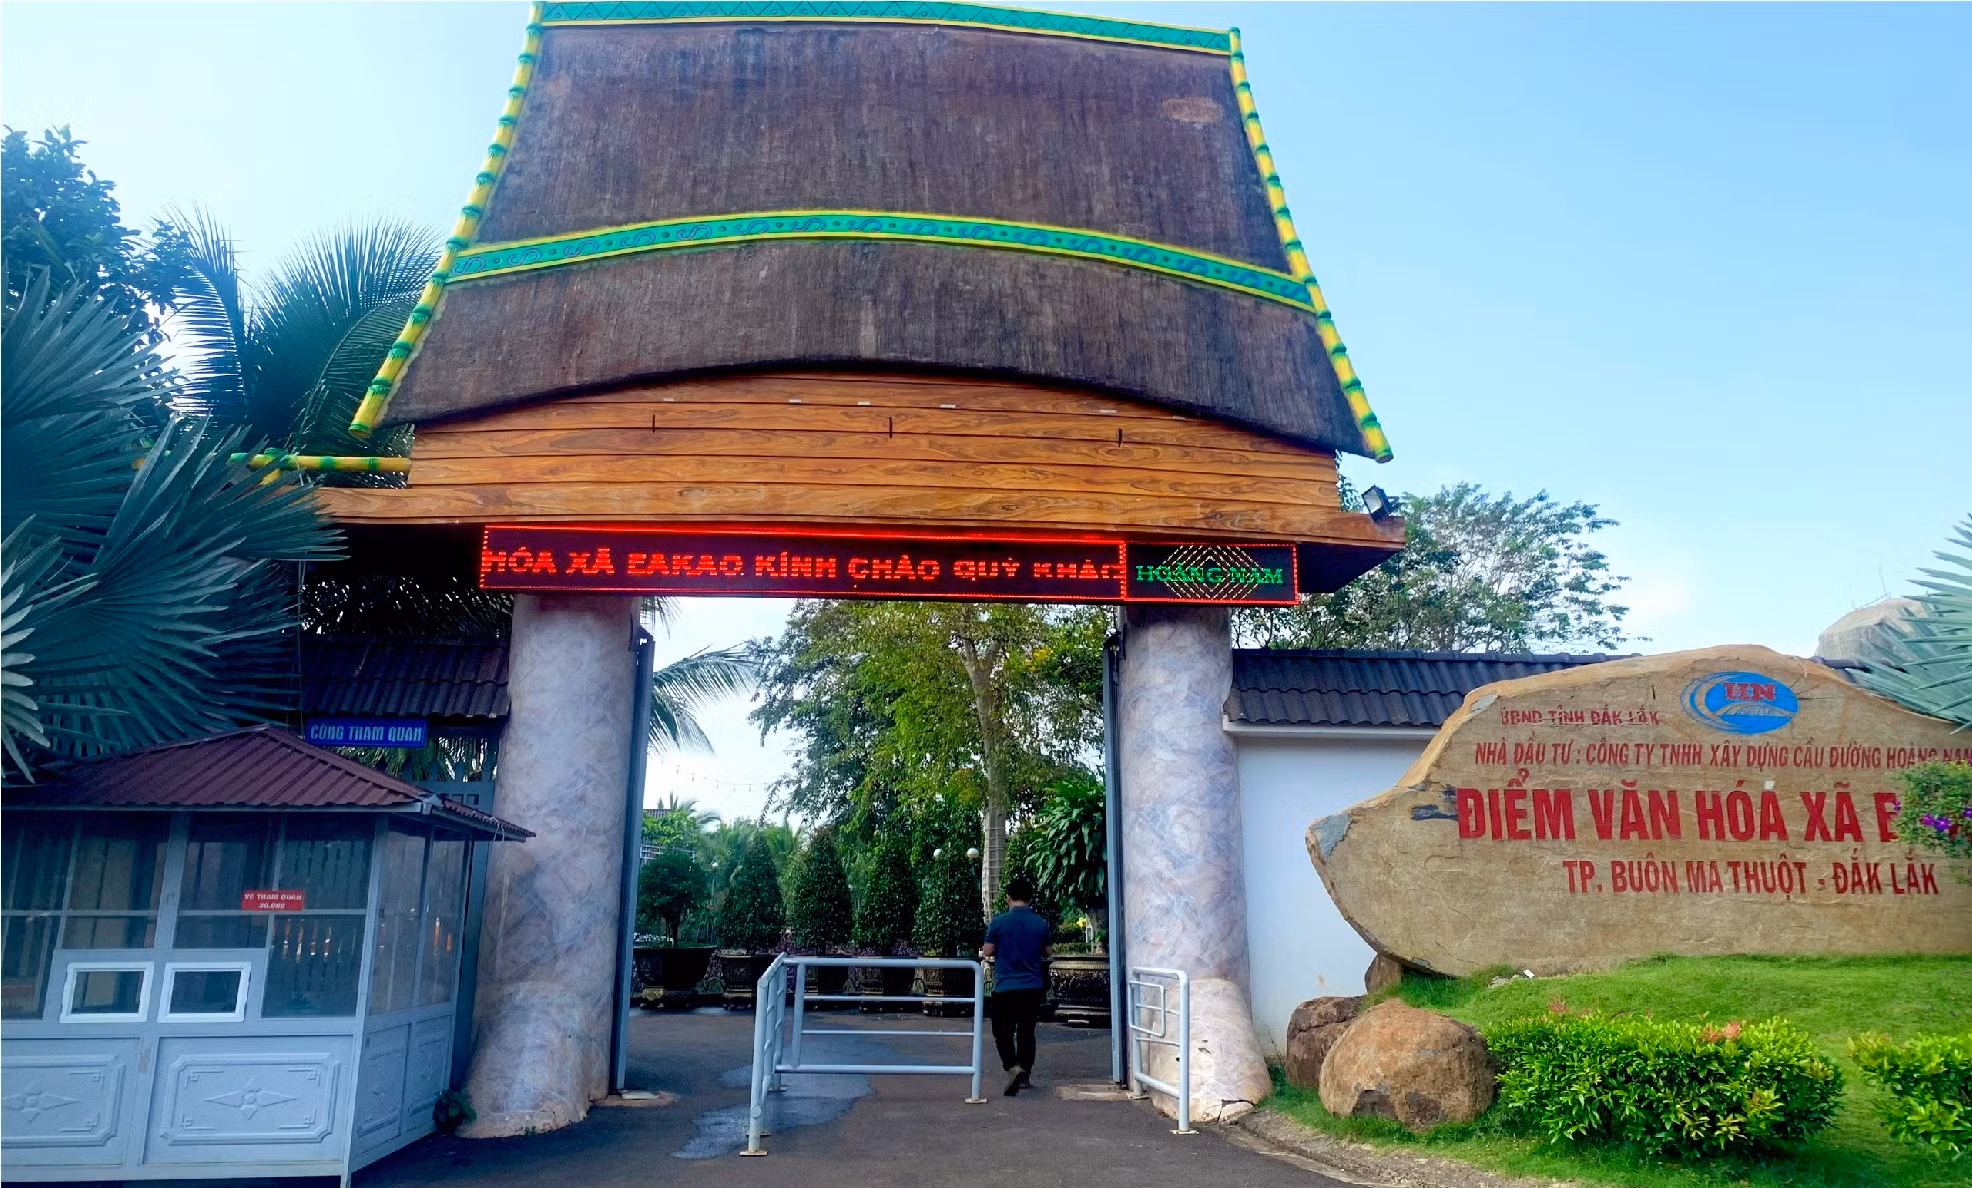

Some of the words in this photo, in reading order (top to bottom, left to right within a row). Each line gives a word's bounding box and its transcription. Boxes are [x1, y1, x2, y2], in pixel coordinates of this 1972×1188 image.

[481, 546, 557, 573] HÓA
[627, 553, 743, 577] EAKAO
[755, 551, 836, 578] KÍNH
[1229, 567, 1283, 584] NAM
[1722, 682, 1777, 702] HN
[1501, 710, 1543, 726] UBND
[348, 726, 385, 741] THAM
[388, 726, 422, 742] QUAN
[1585, 737, 1629, 765] CÔNG
[1634, 743, 1655, 765] TY
[1660, 744, 1703, 766] TNHH
[1709, 739, 1741, 767] XÂY
[1746, 741, 1788, 772] DỰNG
[1456, 768, 1576, 840] ĐIỂM
[1587, 779, 1682, 841] VĂN
[1695, 780, 1789, 842] HÓA
[1799, 781, 1864, 843] XÃ
[1562, 860, 1603, 893] TP.
[1611, 852, 1680, 894] BUÔN
[1685, 860, 1724, 893] MA
[1727, 853, 1807, 900] THUỘT
[1832, 848, 1883, 895] ĐẮK
[1890, 849, 1939, 895] LẮK
